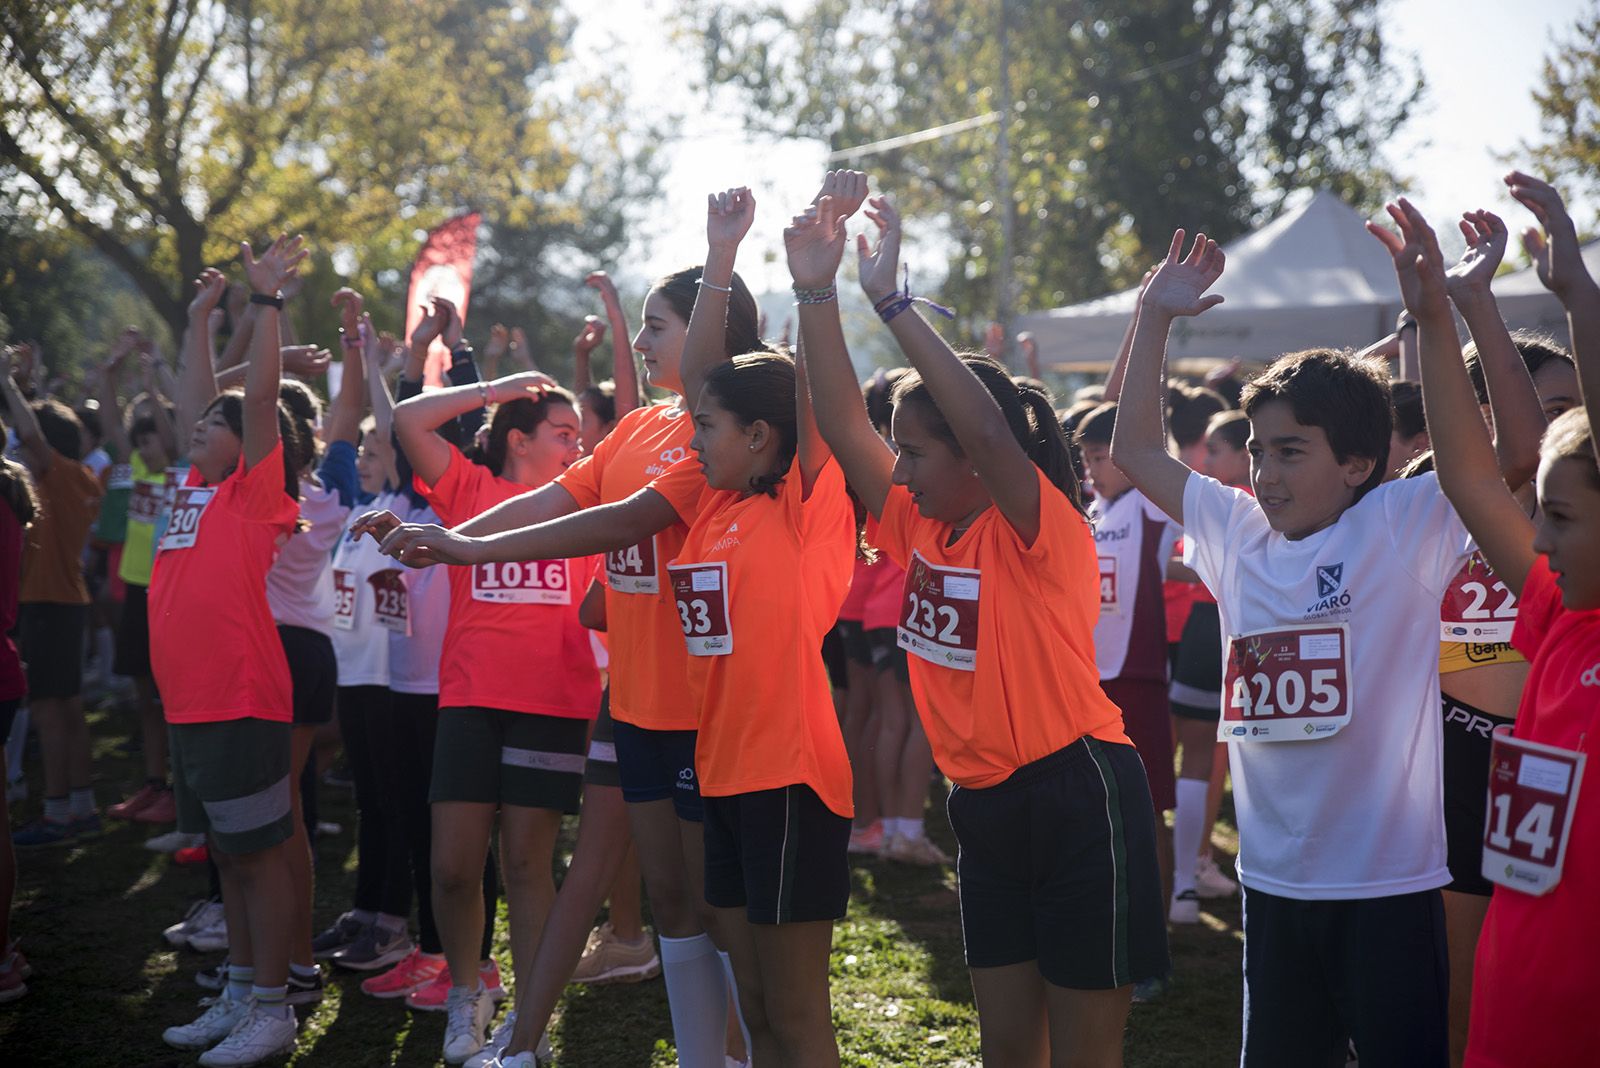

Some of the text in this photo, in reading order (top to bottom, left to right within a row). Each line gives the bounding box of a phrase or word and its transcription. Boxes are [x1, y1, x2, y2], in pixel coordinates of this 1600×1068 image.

[168, 508, 199, 534] 30
[481, 561, 564, 589] 1016
[676, 598, 712, 634] 33
[906, 592, 961, 644] 232
[1303, 611, 1328, 621] GLOBAL
[1231, 669, 1340, 717] 4205
[1490, 793, 1555, 860] 14
